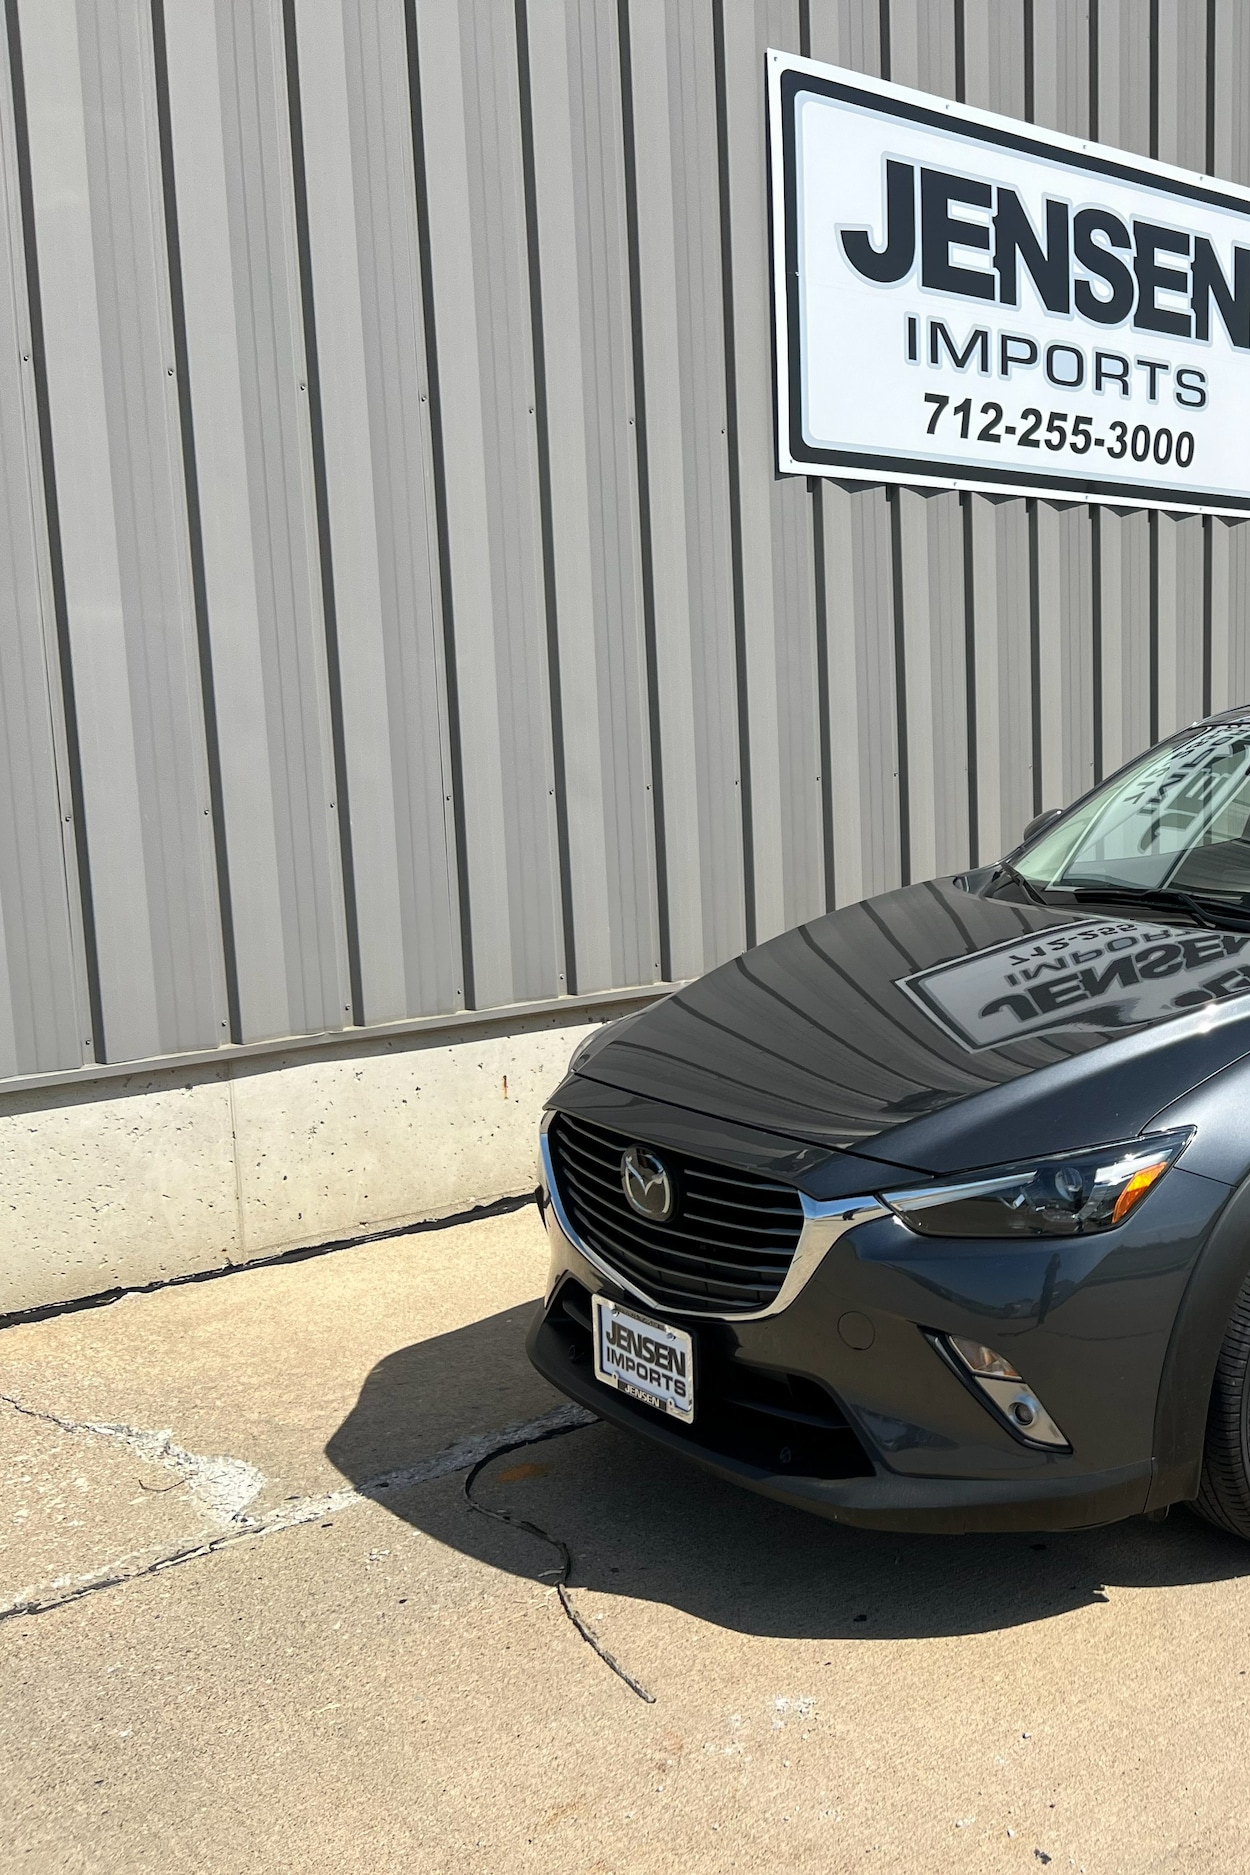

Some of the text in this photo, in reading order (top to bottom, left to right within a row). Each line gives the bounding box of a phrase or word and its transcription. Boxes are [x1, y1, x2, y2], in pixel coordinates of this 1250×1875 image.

[907, 316, 1207, 408] IMPORTS
[924, 393, 1195, 467] 712-255-3000
[606, 1320, 685, 1378] JENSEN
[607, 1347, 686, 1397] IMPORTS
[625, 1384, 660, 1407] JENSEN
